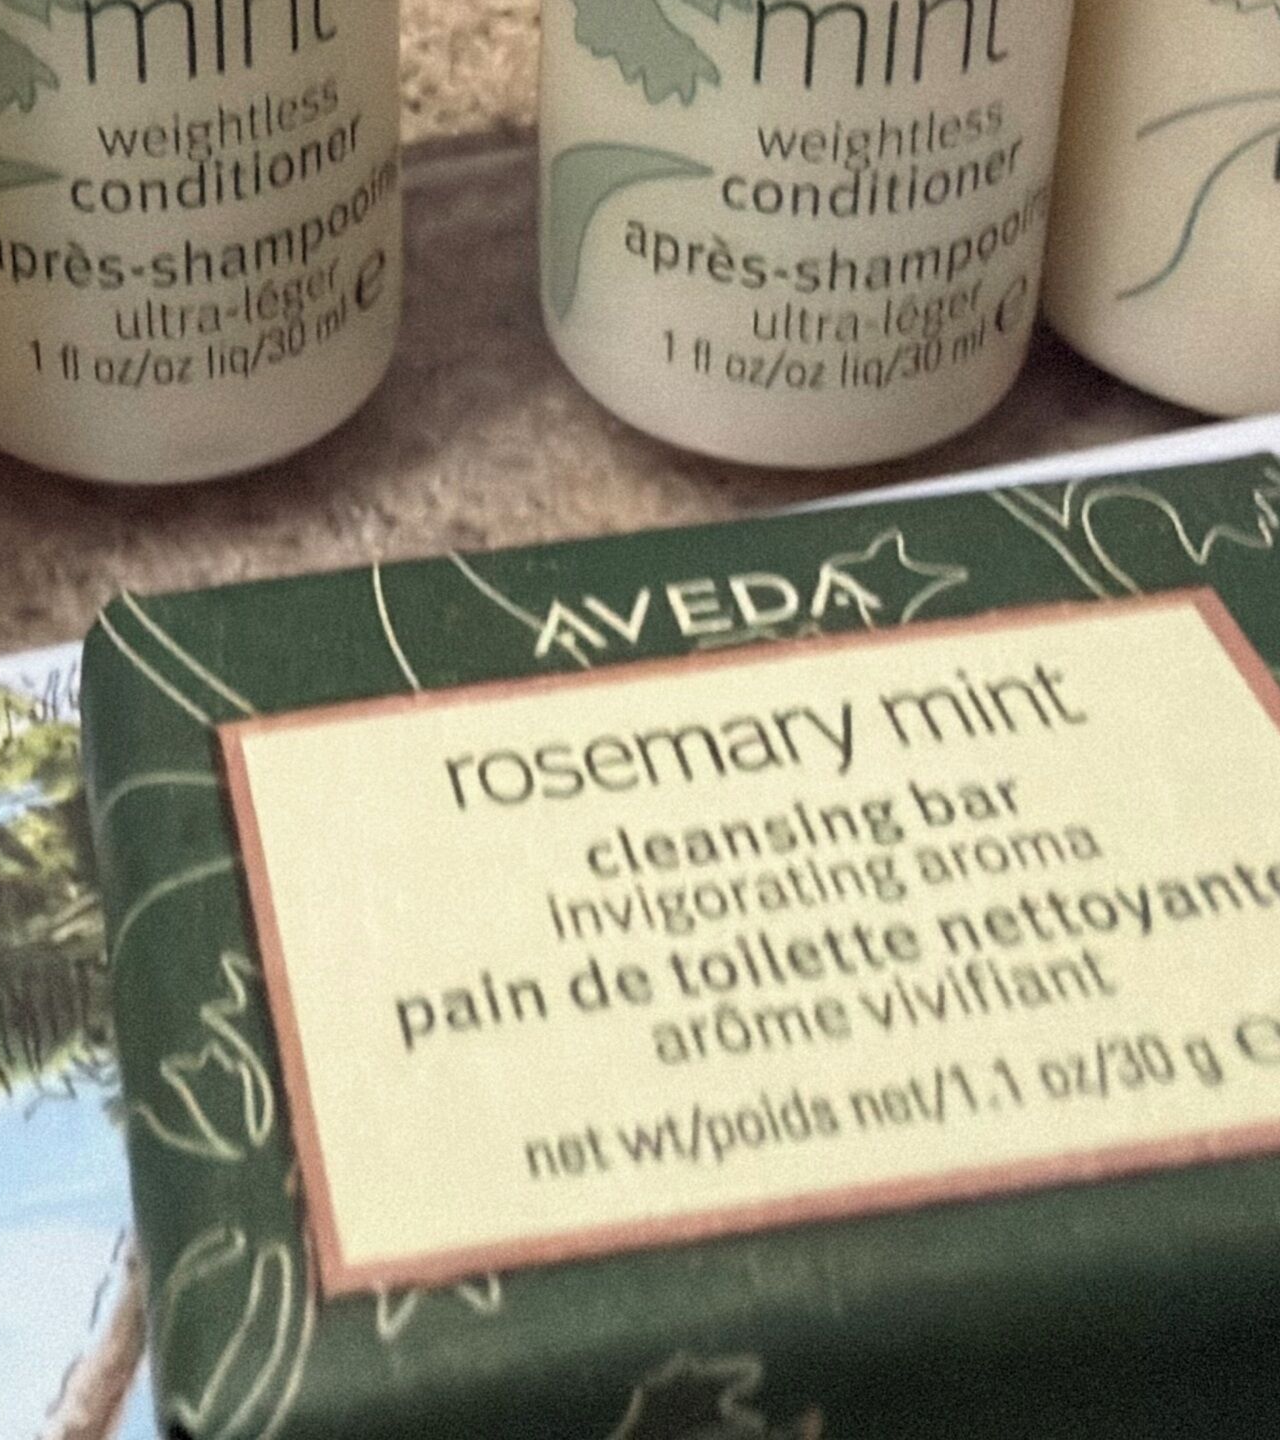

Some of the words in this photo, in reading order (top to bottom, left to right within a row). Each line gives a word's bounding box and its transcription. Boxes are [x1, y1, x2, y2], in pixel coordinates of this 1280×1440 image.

[70, 114, 362, 214] conditioner
[97, 78, 340, 162] weightless
[757, 103, 1004, 171] weightless
[722, 138, 1022, 219] conditioner
[116, 257, 340, 342] ultra-léger
[31, 340, 43, 373] 1
[93, 348, 193, 388] oz/oz
[664, 329, 674, 363] 1
[725, 348, 825, 389] oz/oz
[533, 561, 885, 659] AVEDA
[442, 700, 855, 812] rosemary
[879, 662, 1089, 749] mint
[586, 797, 907, 880] cleansing
[908, 776, 1021, 830] bar
[546, 854, 908, 943] invigorating
[916, 819, 1103, 887] aroma
[394, 970, 551, 1053] pain
[567, 955, 657, 1015] de
[669, 917, 924, 1001] toilette
[649, 992, 854, 1067] arôme
[857, 946, 1120, 1034] vivifiant
[523, 1130, 608, 1180] net
[616, 1086, 842, 1172] wt/poids
[850, 1056, 1025, 1130] net/1.1
[1038, 1035, 1175, 1102] oz/30
[1186, 1038, 1226, 1088] g
